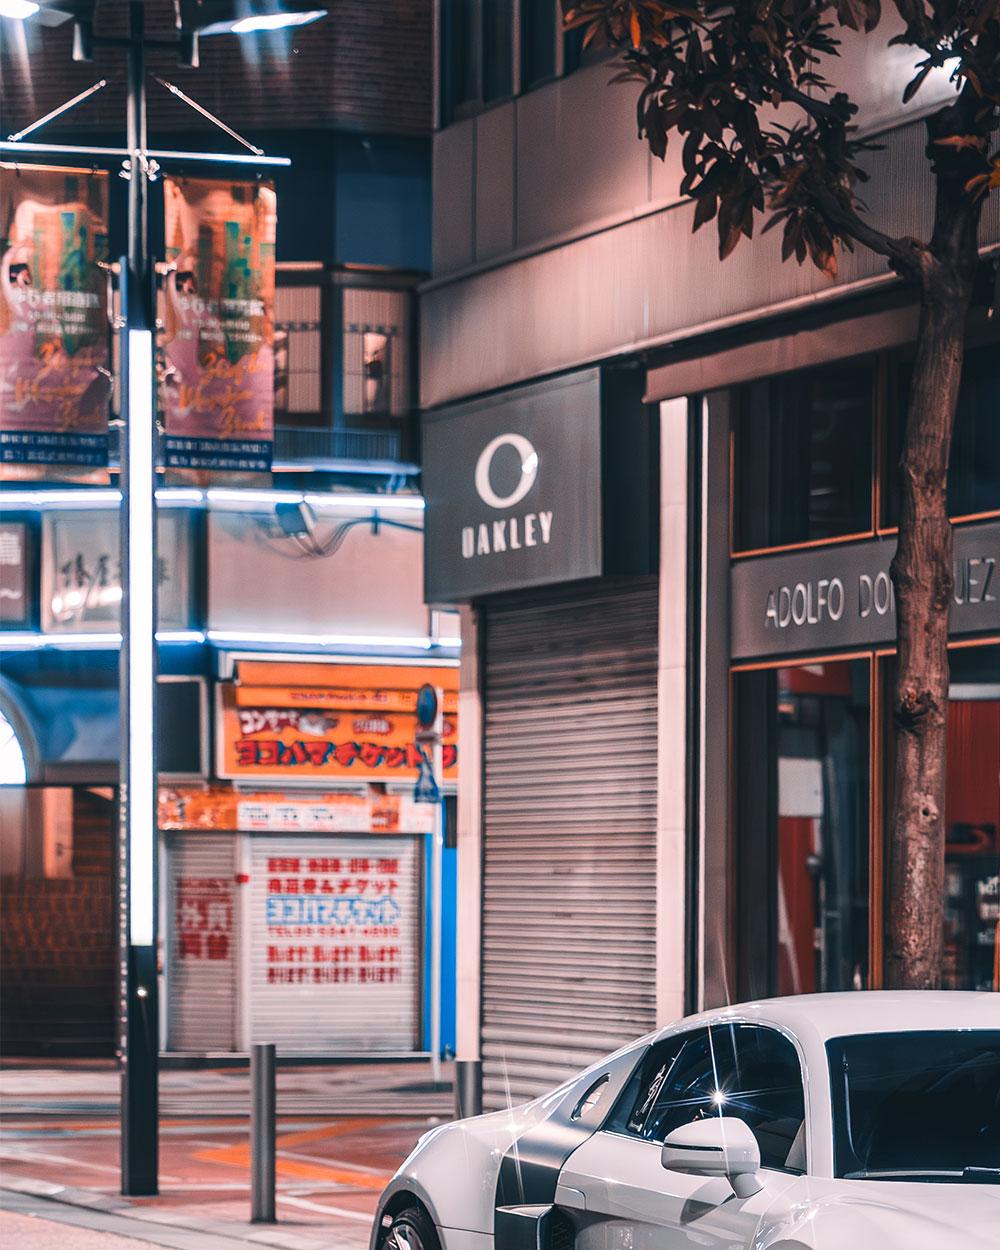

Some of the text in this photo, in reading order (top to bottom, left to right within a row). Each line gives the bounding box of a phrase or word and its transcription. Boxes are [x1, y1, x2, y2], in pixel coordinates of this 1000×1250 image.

[462, 511, 553, 558] OAKLEY
[764, 558, 996, 628] ADOLFO DOUEZ
